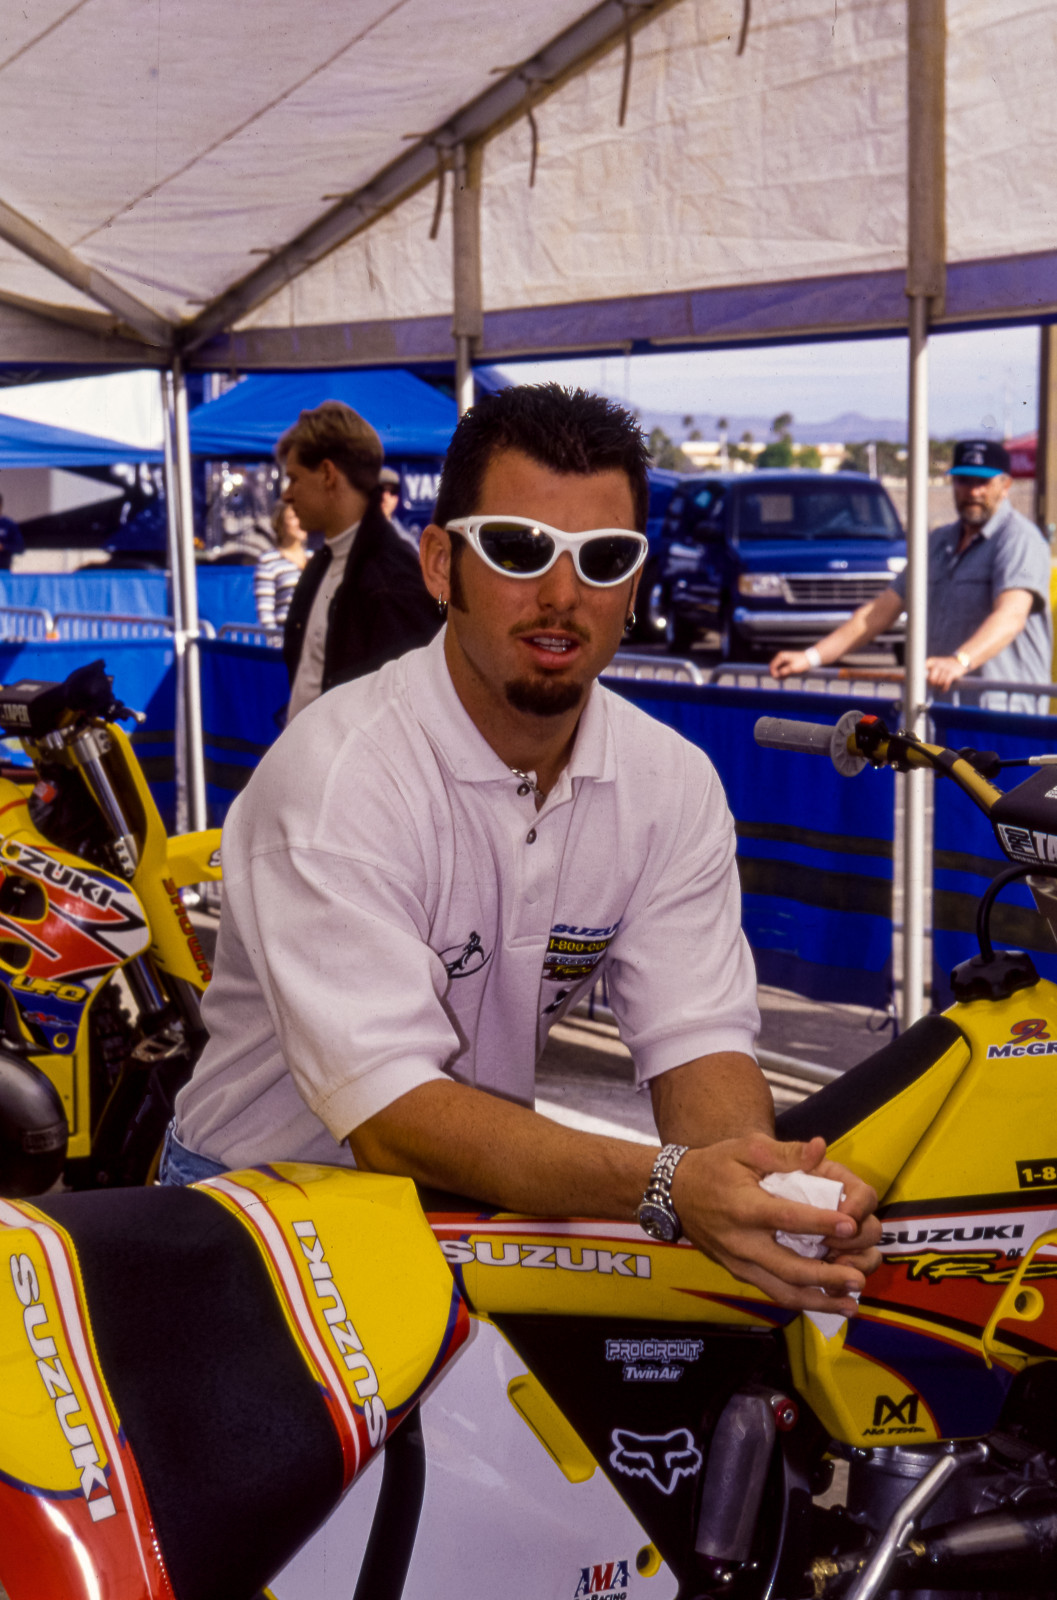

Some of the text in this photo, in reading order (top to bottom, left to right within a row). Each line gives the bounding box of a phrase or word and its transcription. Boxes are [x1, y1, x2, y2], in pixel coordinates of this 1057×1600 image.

[11, 974, 88, 1003] UFO
[874, 1224, 1025, 1247] SUZUKI
[438, 1239, 652, 1280] SUZUKI
[292, 1220, 388, 1449] SUZUKI
[607, 1341, 702, 1361] PRO CIRCUIT
[9, 1252, 117, 1524] SUZUKI
[625, 1366, 681, 1379] Twin Air
[574, 1560, 630, 1598] AMA
